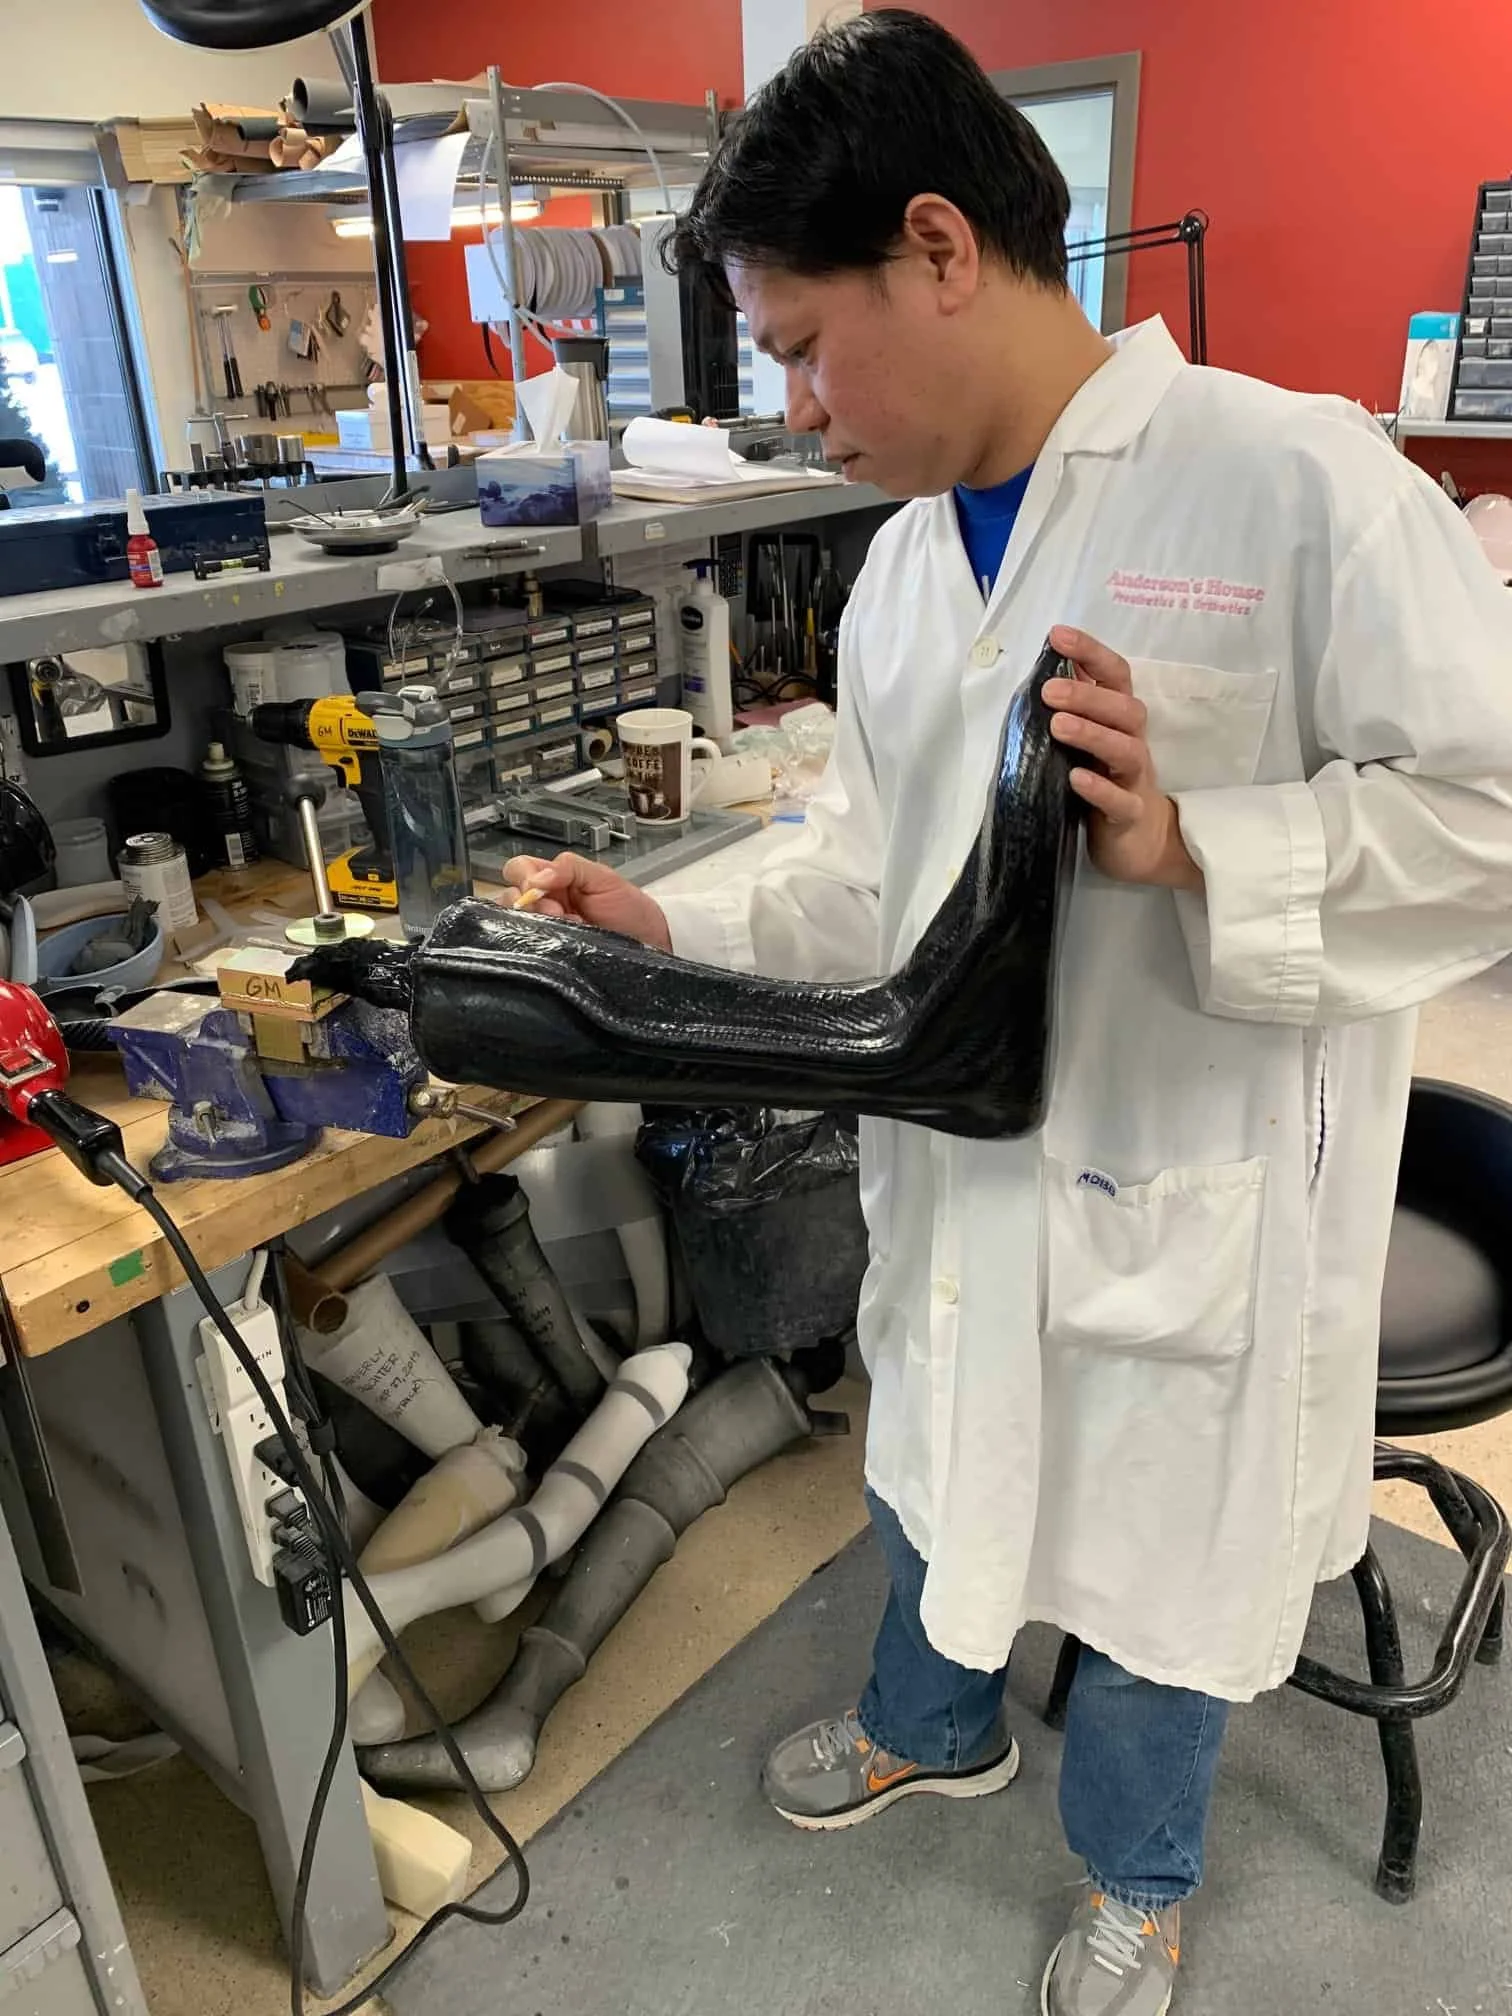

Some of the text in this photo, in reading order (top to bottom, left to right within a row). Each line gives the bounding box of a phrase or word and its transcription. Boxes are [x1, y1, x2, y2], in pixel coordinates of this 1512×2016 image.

[1105, 570, 1265, 602] Anderson's House
[246, 975, 281, 998] GM
[235, 1348, 272, 1374] BKIN
